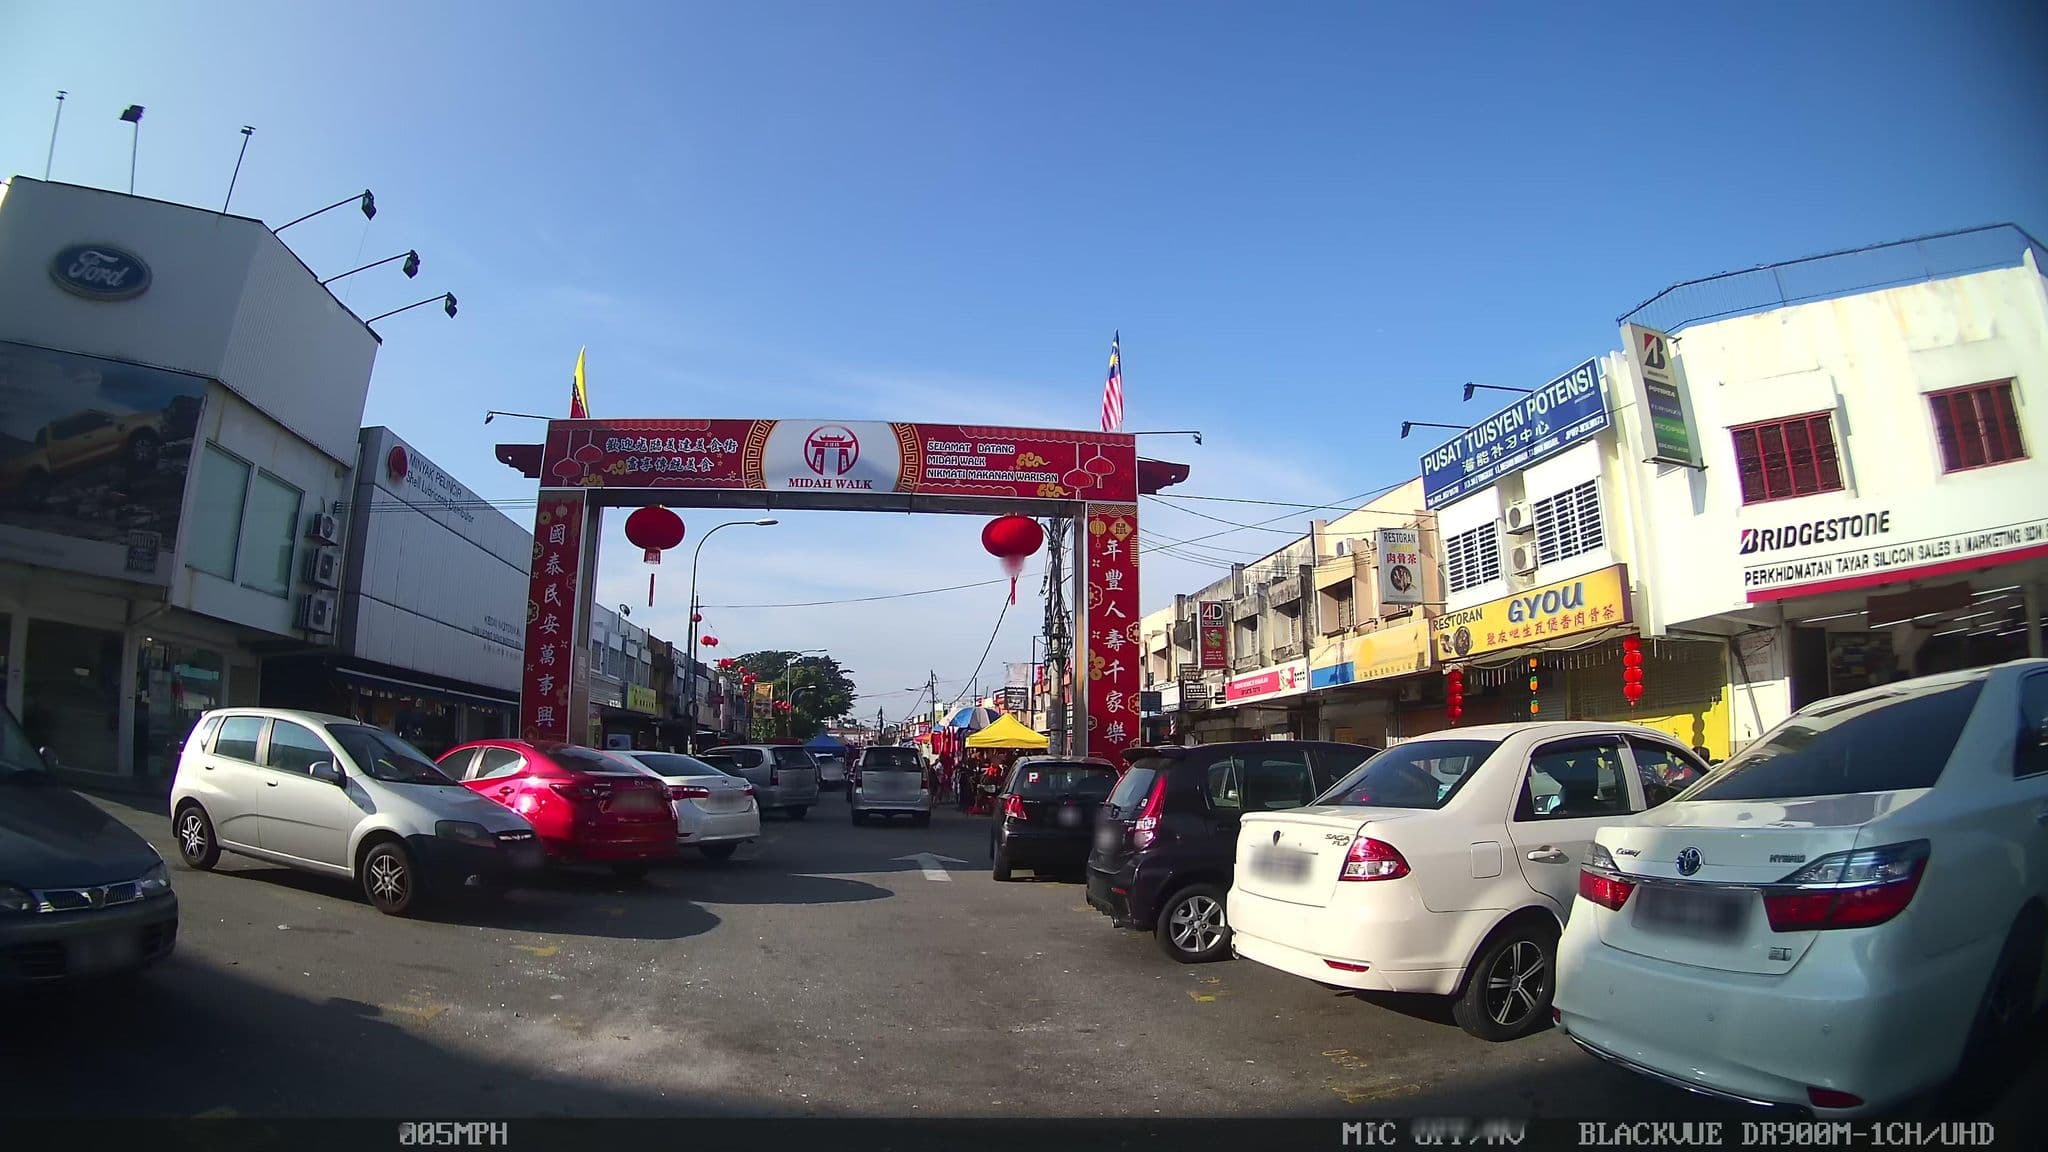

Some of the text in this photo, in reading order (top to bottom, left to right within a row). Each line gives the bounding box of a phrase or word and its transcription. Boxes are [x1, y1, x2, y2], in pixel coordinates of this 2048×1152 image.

[68, 250, 129, 287] Ford
[1424, 439, 1462, 476] PUSAT
[1465, 405, 1524, 451] TUISYEN
[1526, 366, 1594, 420] POTENSI
[927, 441, 1015, 454] SELAMAT DATANG
[409, 452, 434, 482] MINYAK
[927, 455, 986, 467] MIDAH WALK
[788, 478, 873, 490] MIDAH WALK
[926, 468, 1059, 484] NIKMATI MAKANAN WARISAN
[1384, 532, 1416, 544] RESTORAN
[1740, 510, 1890, 555] BRIDGESTONE
[1386, 553, 1417, 565] 肉骨茶
[1744, 560, 1832, 586] PERKHIDMATAN
[1837, 554, 1869, 571] TAYAR
[1873, 546, 1914, 568] SILICON
[1919, 540, 1951, 560] SALES
[1965, 529, 2021, 552] MARKETING
[1202, 604, 1224, 620] 4D
[1507, 582, 1585, 623] GYOU
[535, 523, 566, 728] 國泰民安萬事興
[1433, 608, 1483, 631] RESTORAN
[1102, 538, 1128, 745] 年豐人壽千家樂
[1028, 772, 1039, 783] P
[1324, 833, 1350, 841] SAGA
